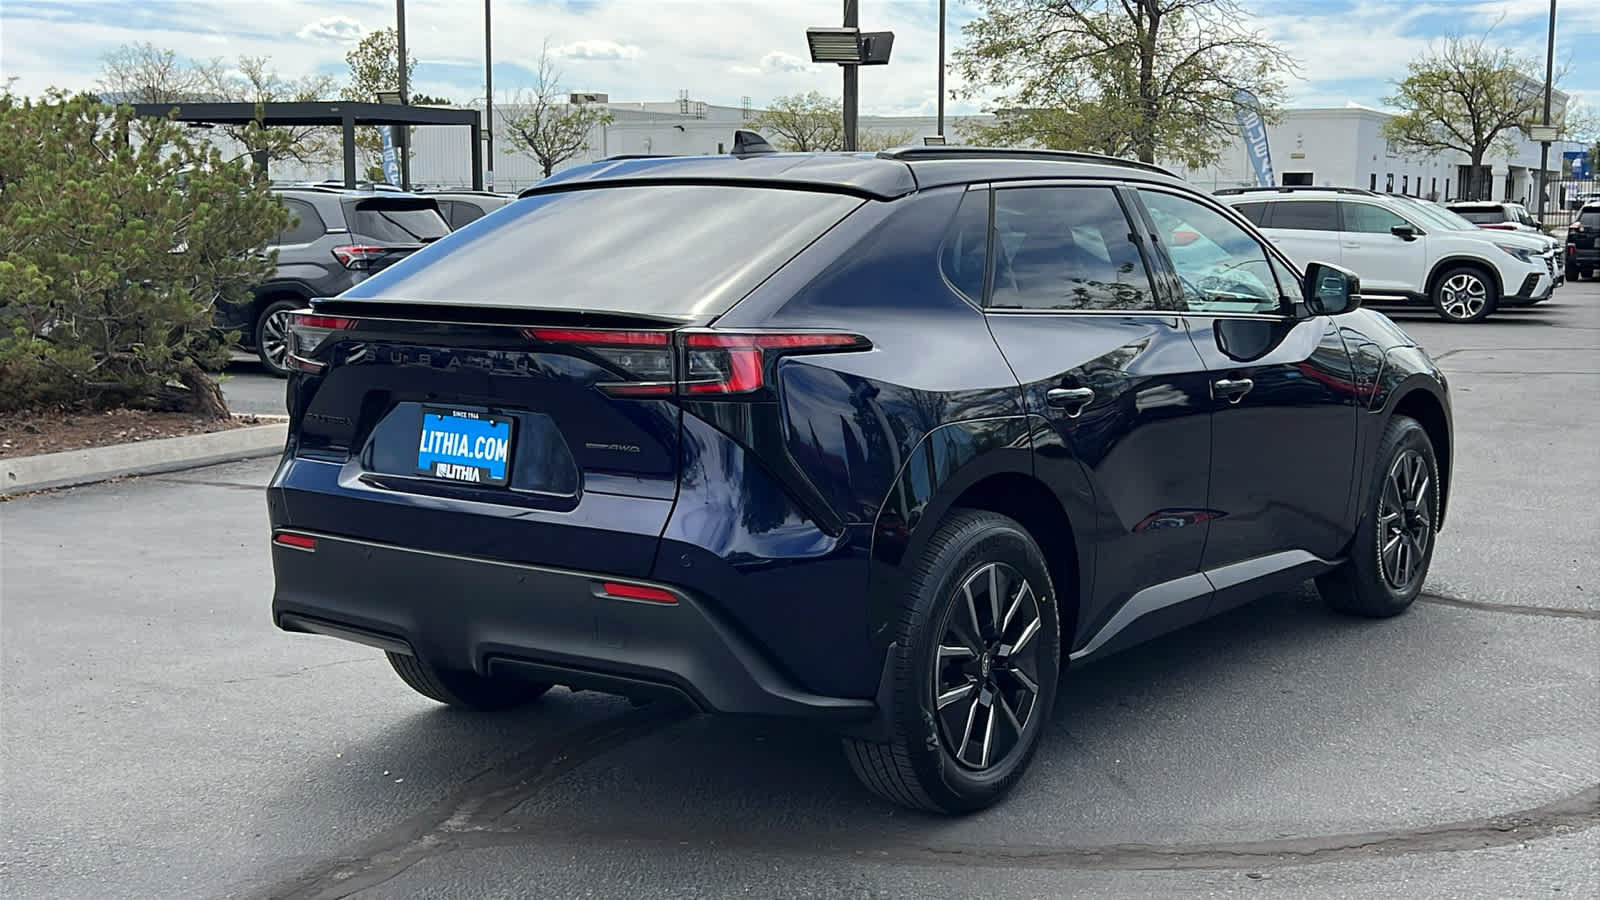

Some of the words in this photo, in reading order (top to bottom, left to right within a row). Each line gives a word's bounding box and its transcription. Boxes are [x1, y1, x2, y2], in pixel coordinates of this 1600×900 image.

[366, 347, 531, 370] SUBARU
[452, 410, 467, 418] SINCE
[420, 429, 508, 462] LITHIA.COM
[608, 444, 641, 453] AWD
[446, 463, 480, 482] LITHIA
